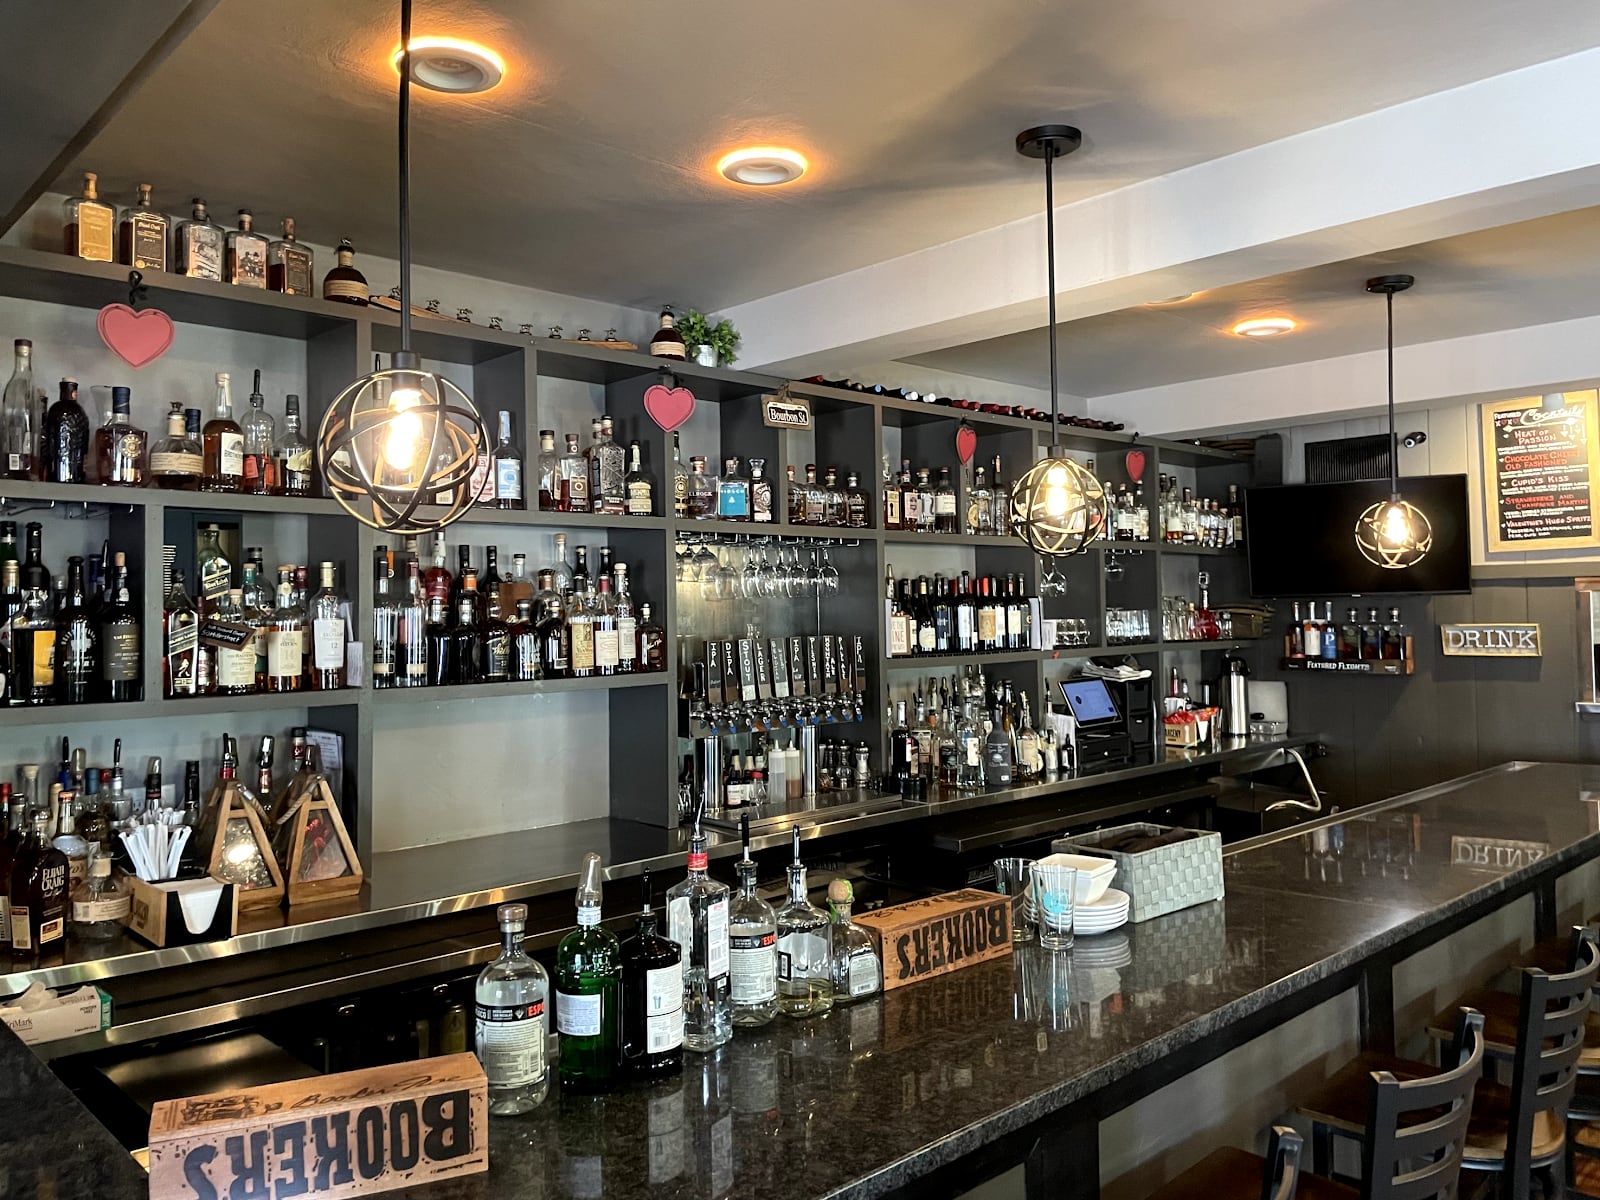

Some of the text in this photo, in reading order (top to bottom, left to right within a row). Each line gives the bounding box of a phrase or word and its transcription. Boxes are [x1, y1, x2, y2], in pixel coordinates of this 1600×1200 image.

[770, 408, 798, 423] Bourbon
[1514, 429, 1537, 440] HEAT
[1518, 433, 1557, 446] PASSION
[1504, 452, 1549, 464] CHOCOLATE
[1505, 459, 1568, 471] OLD FASHIONED
[1511, 475, 1569, 487] CUPID'S KISS
[1325, 633, 1335, 646] P
[1446, 629, 1537, 650] DRINK
[725, 642, 734, 676] DIPA
[742, 641, 754, 682] STOUT
[756, 642, 766, 682] LAGER
[1307, 660, 1336, 670] FEATURED
[42, 865, 65, 880] ELIJAH
[41, 876, 65, 892] CRAIG
[897, 903, 1009, 980] BOOKER'S
[183, 1089, 470, 1200] BOOKERS
